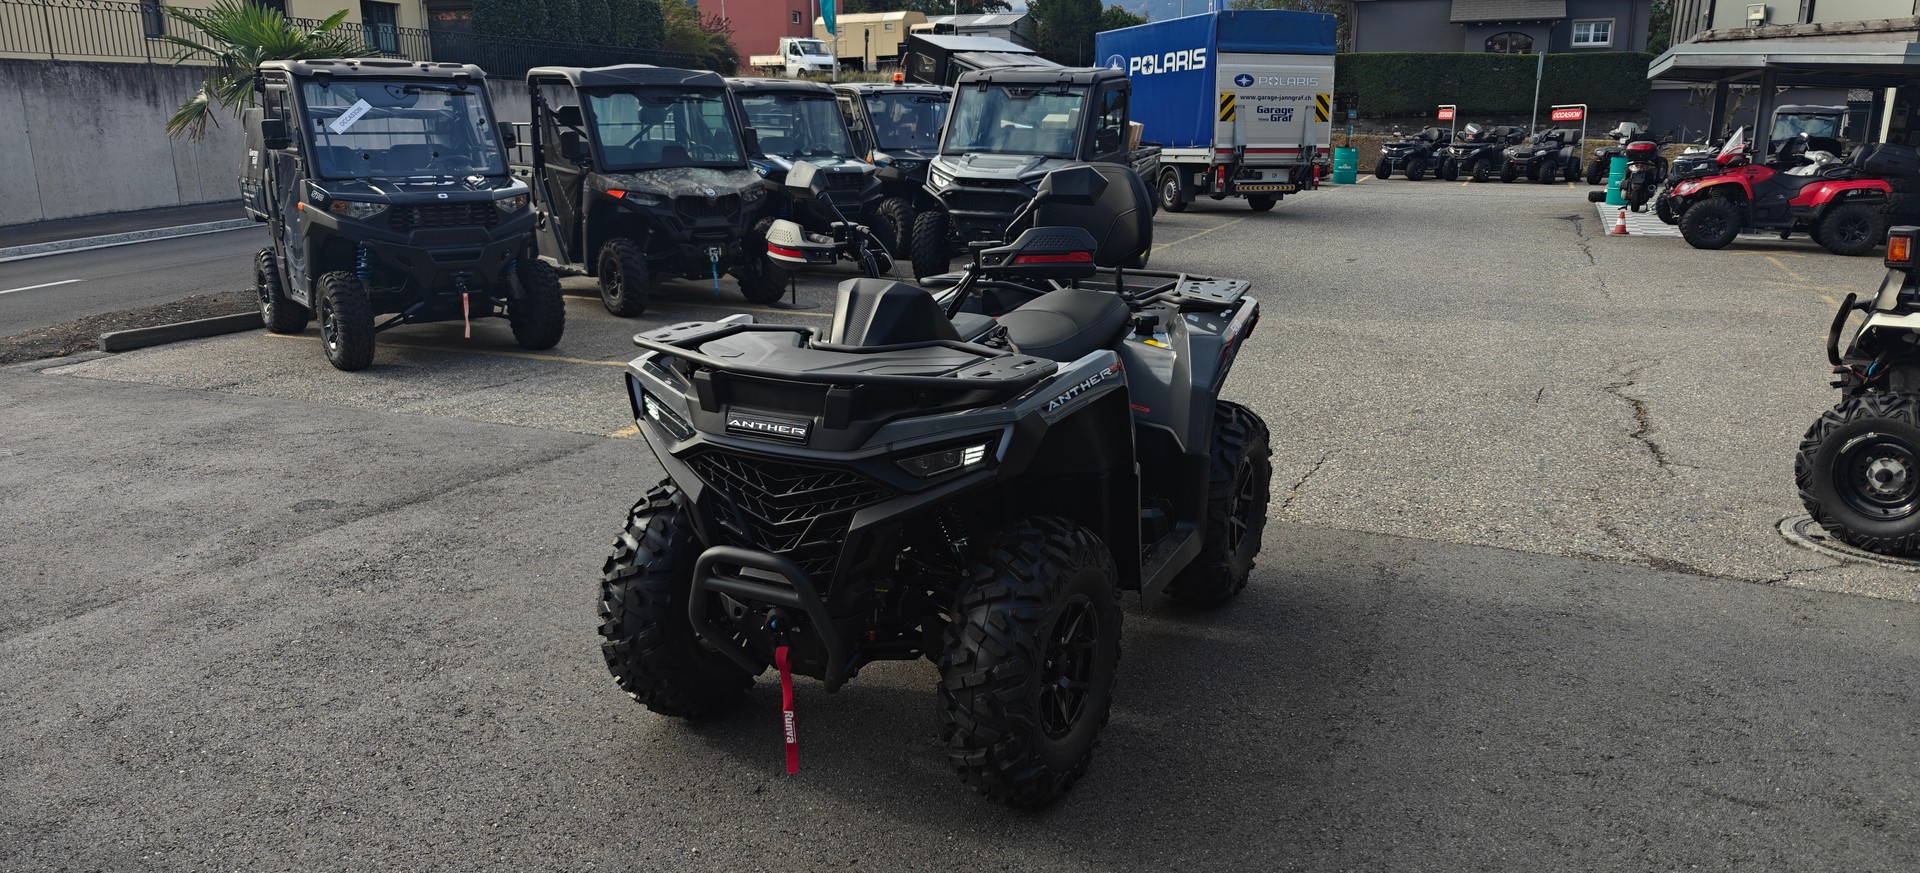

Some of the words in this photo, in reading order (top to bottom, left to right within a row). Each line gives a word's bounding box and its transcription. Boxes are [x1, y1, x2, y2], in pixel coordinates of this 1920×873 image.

[1129, 47, 1206, 77] POLARIS
[1258, 76, 1319, 87] POLARIS
[1240, 94, 1312, 102] www.garage-janngraf.ch
[339, 105, 363, 127] OCCASION
[1256, 105, 1294, 116] Garage
[1553, 111, 1582, 119] OCCASION
[1270, 114, 1293, 122] Graf
[1048, 367, 1113, 412] ANTHER
[729, 419, 806, 435] ANTHER
[783, 710, 795, 744] Runva
